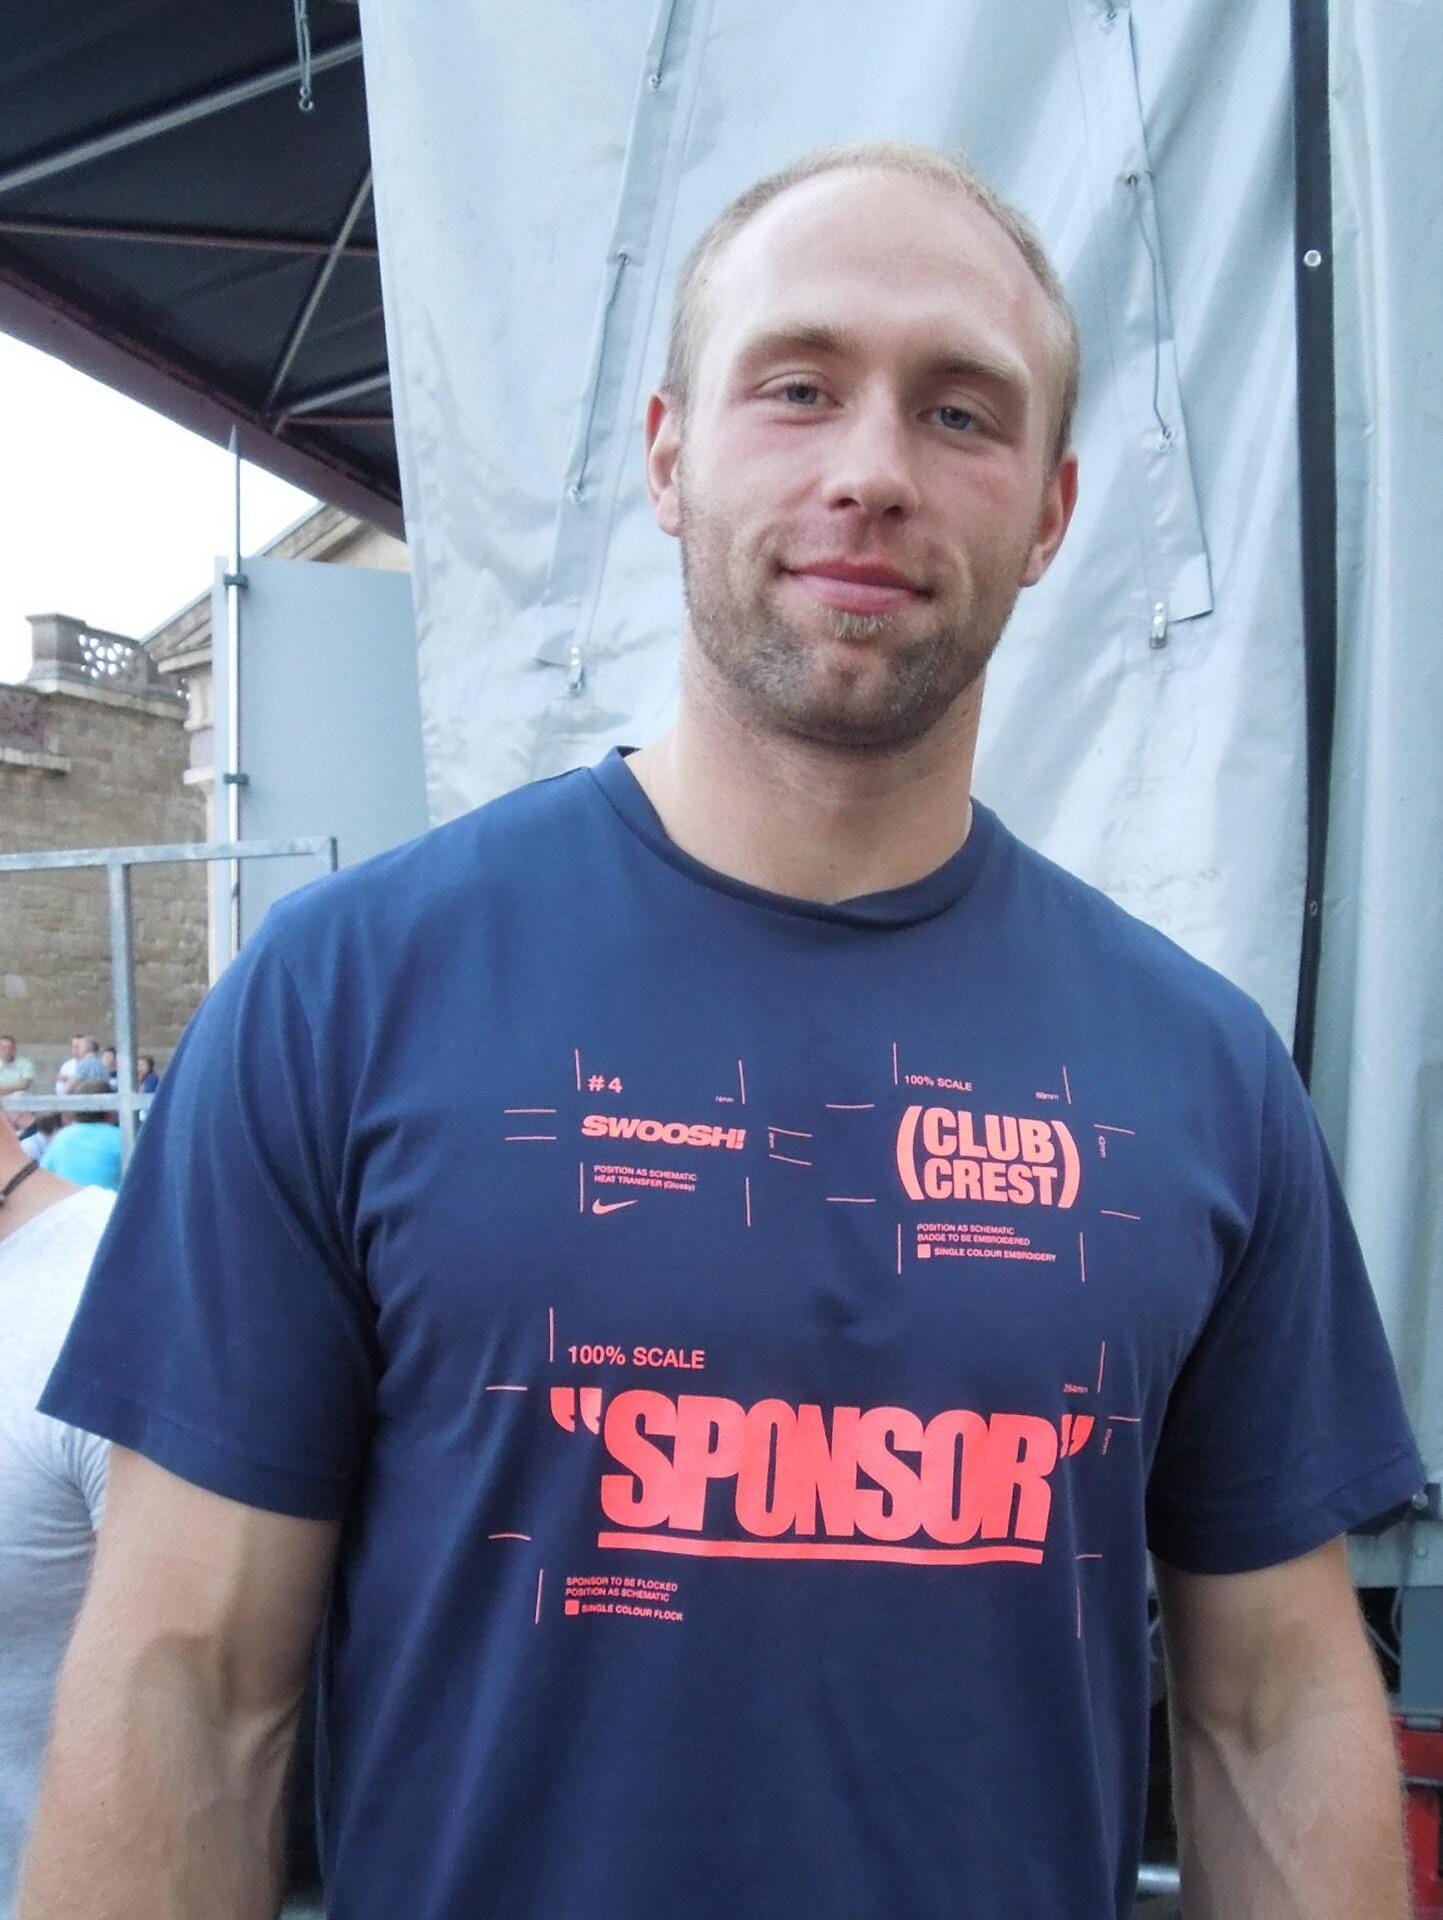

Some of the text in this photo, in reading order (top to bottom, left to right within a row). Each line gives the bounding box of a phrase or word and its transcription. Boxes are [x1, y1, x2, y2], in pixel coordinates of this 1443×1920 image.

[608, 1077, 622, 1093] 4
[904, 1075, 972, 1092] 100% SCALE
[581, 1115, 746, 1150] SWOOSH!
[594, 1165, 697, 1181] POSITION AS SCHEMATIC
[594, 1175, 616, 1183] HEAT
[618, 1176, 662, 1187] TRANSFER
[917, 1224, 1015, 1235] POSITION AS SCHEMATIC
[917, 1234, 946, 1242] BADGE
[973, 1235, 1030, 1246] EMBROIDERED
[934, 1247, 1057, 1262] SINGLE COLOUR EMBROIDERY
[568, 1345, 705, 1369] 100% SCALE
[566, 1577, 678, 1592] SPONSOR TO BE FLOCKED
[565, 1587, 670, 1602] POSITION AS SCHEMATIC
[581, 1604, 683, 1622] SINGLE COLOUR FLOCK
